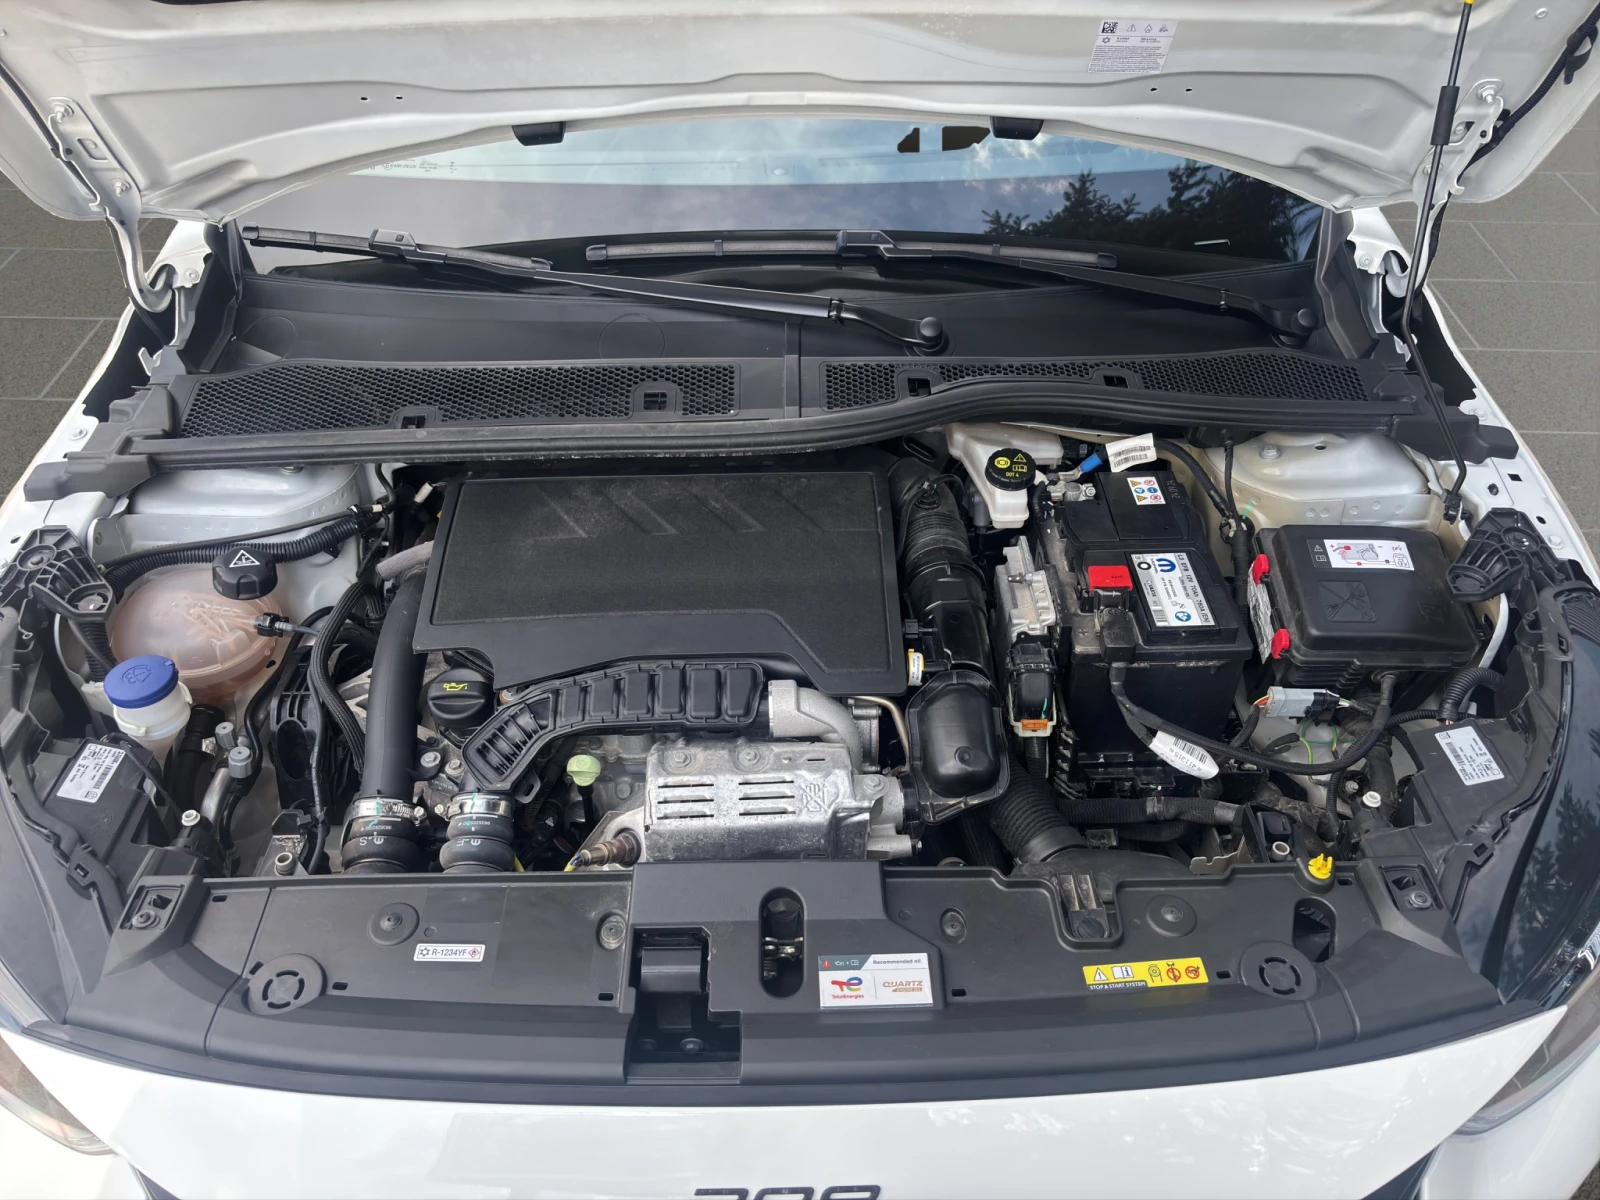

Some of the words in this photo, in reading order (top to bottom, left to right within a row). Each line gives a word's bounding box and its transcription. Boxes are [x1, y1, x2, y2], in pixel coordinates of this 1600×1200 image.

[1180, 562, 1189, 572] EFB
[1186, 574, 1194, 583] 12V
[1190, 585, 1199, 598] 70Ah
[431, 948, 467, 957] R-1234YF
[882, 980, 923, 988] QUARTZ
